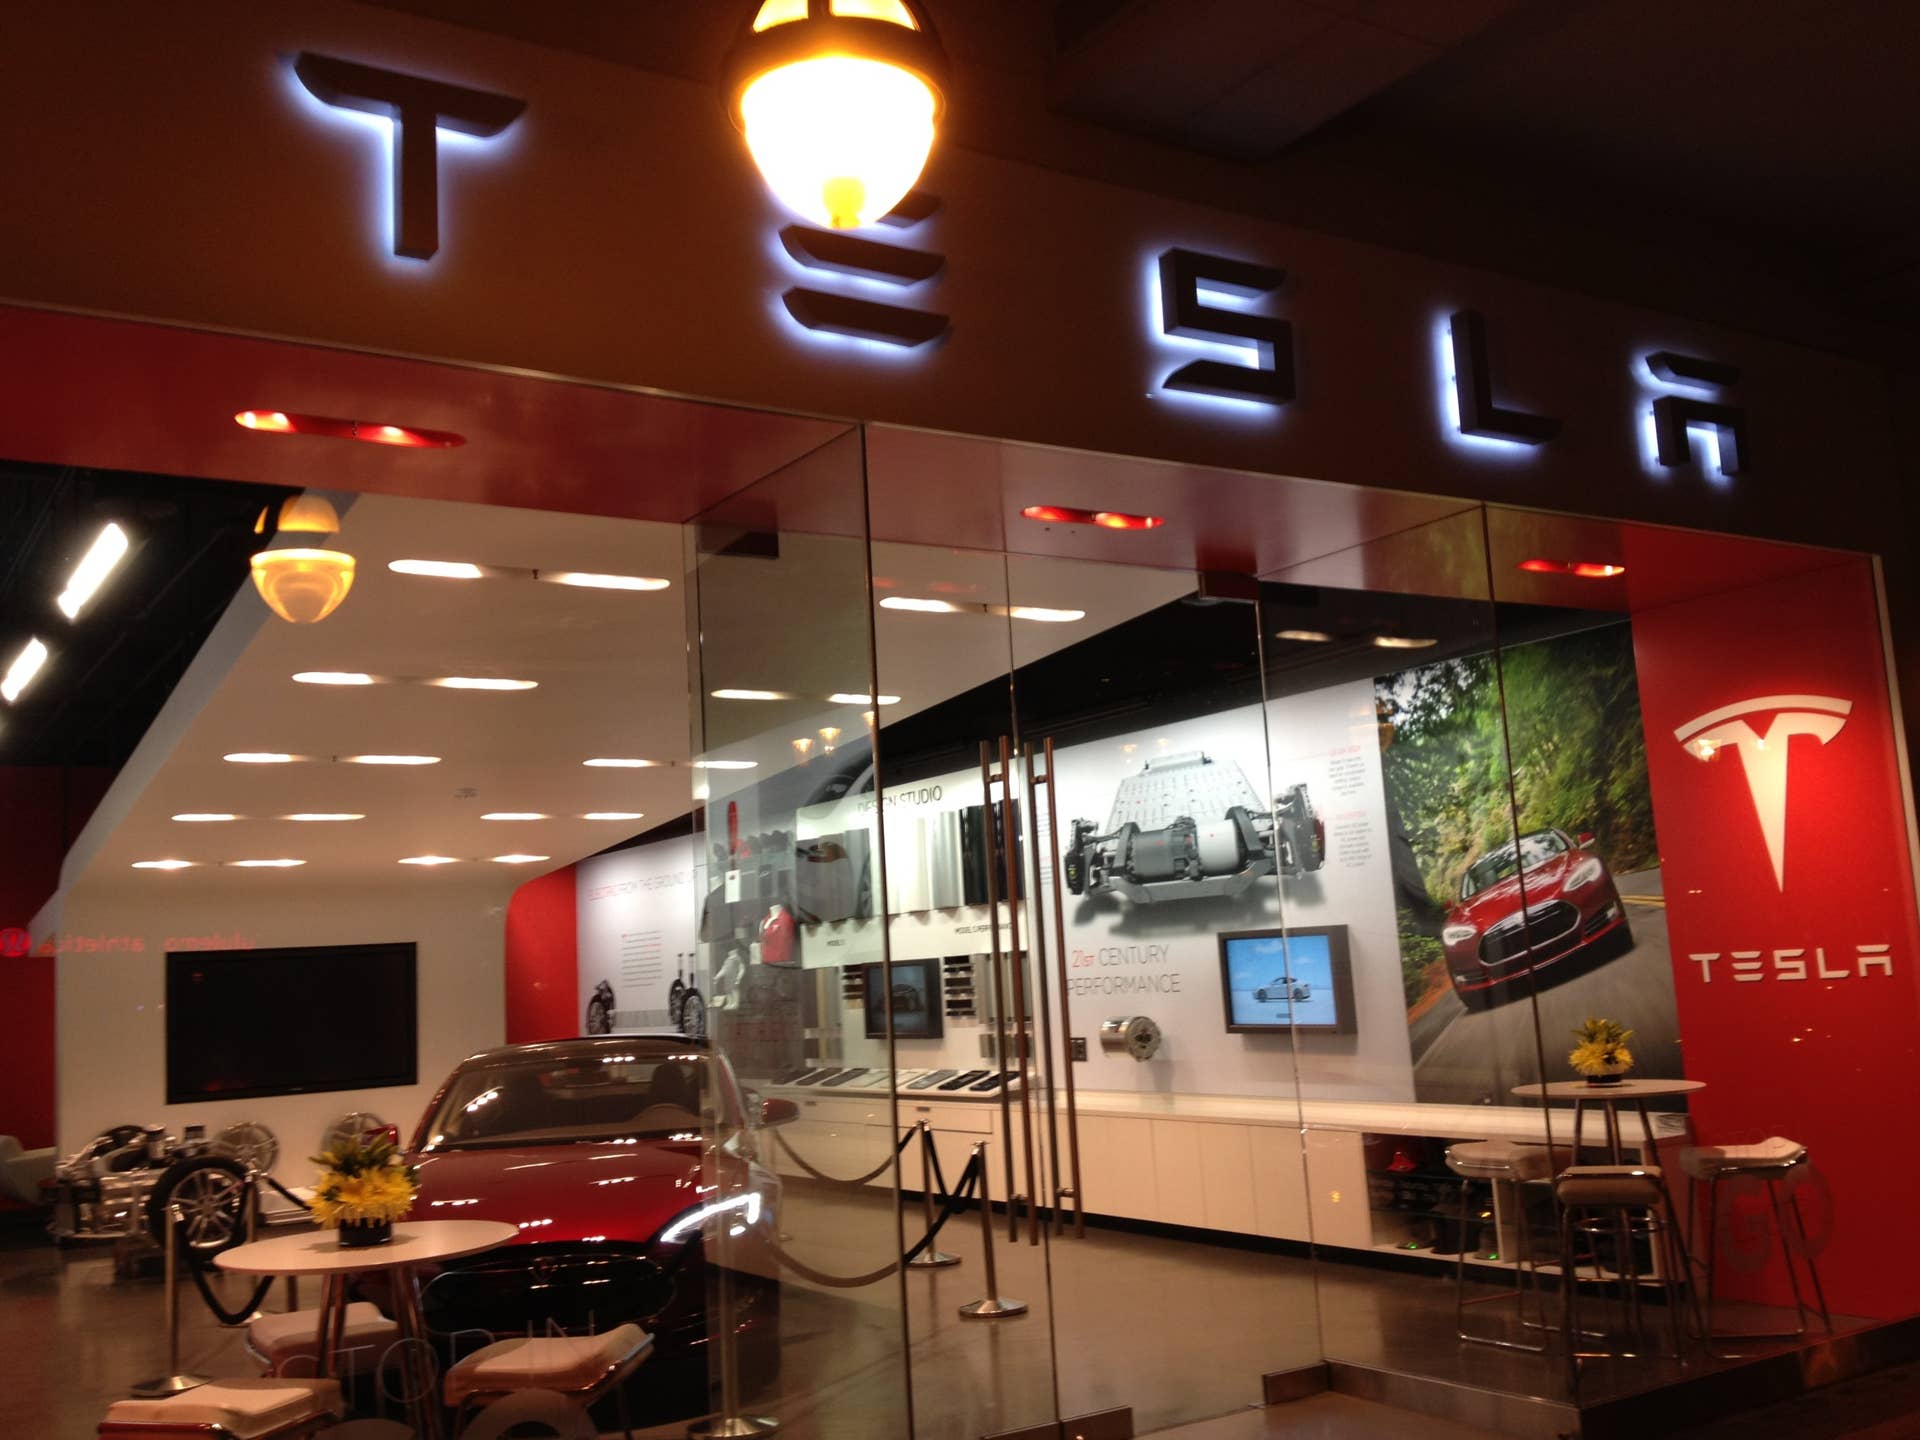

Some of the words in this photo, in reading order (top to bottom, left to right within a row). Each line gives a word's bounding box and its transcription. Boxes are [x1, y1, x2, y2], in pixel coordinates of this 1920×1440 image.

[288, 52, 1744, 478] TESLA
[899, 785, 943, 806] STUDIO
[1098, 944, 1170, 967] CENTURY
[1688, 943, 1893, 984] TESLA
[1067, 973, 1181, 996] PERFORMANCE
